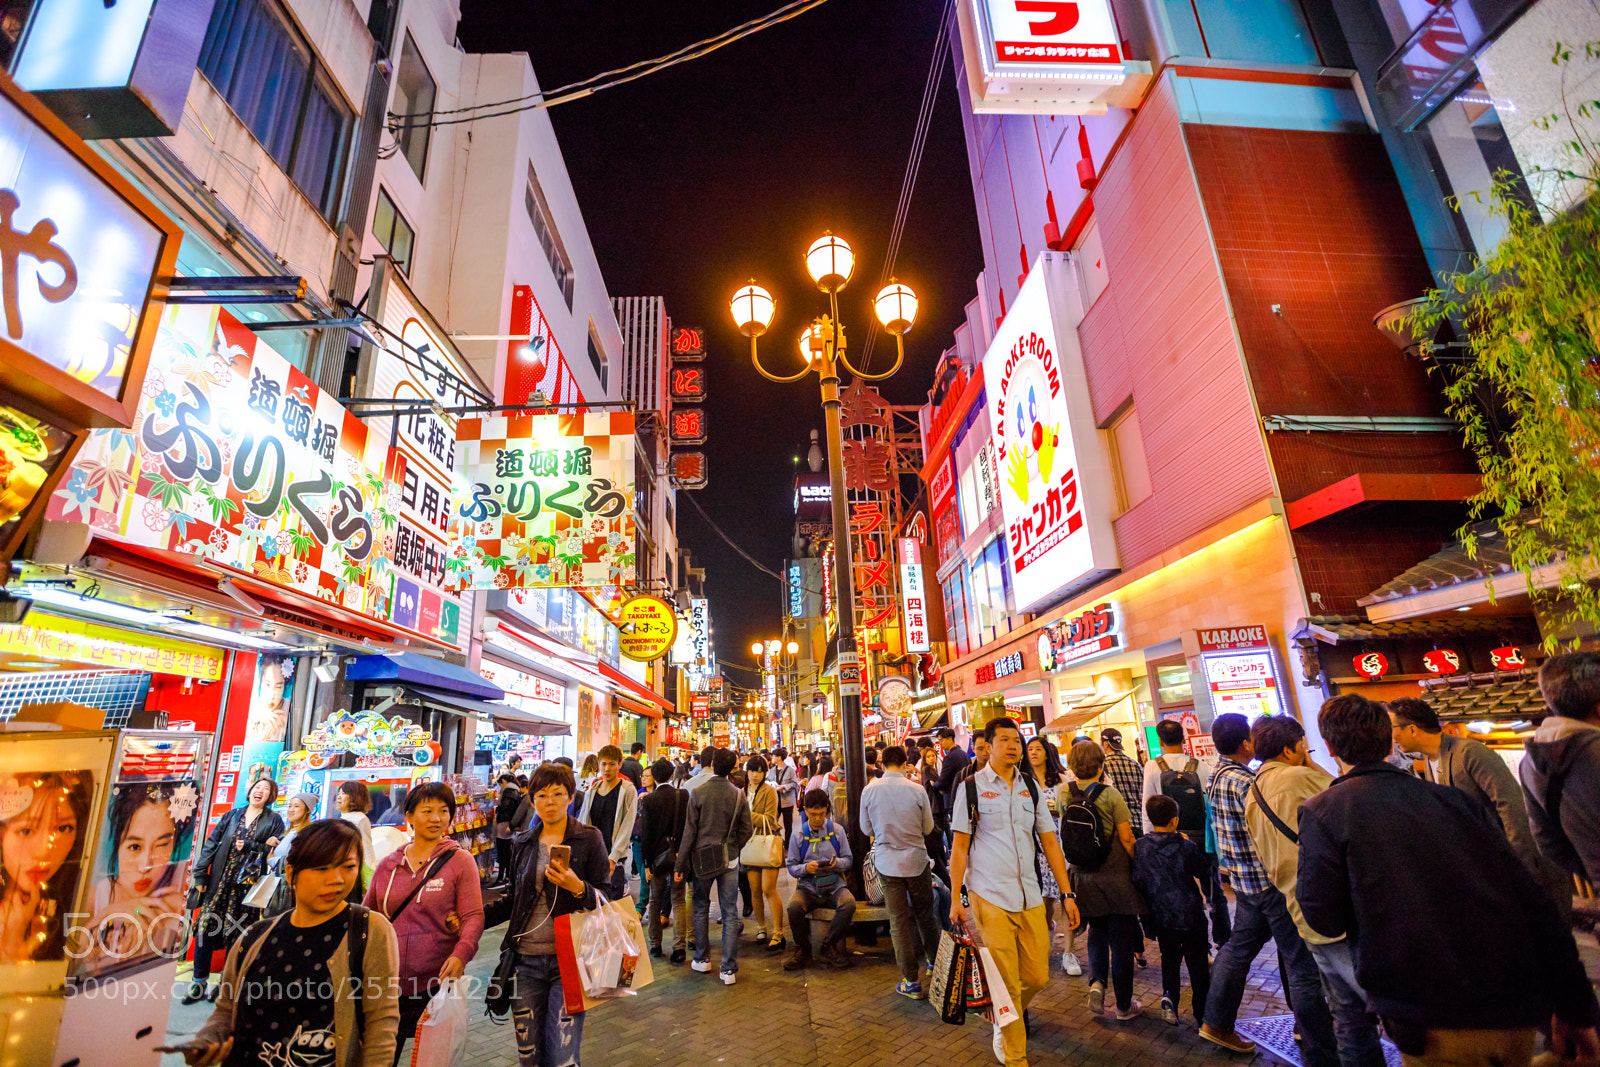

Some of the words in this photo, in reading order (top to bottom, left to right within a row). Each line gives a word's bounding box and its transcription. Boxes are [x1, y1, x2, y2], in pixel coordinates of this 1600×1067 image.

[249, 366, 340, 466] 道頓堀
[495, 448, 593, 478] 道頓堀
[459, 478, 627, 523] ぷりくら
[1009, 467, 1077, 556] ジャンカラ
[1200, 627, 1264, 645] KARAOKE
